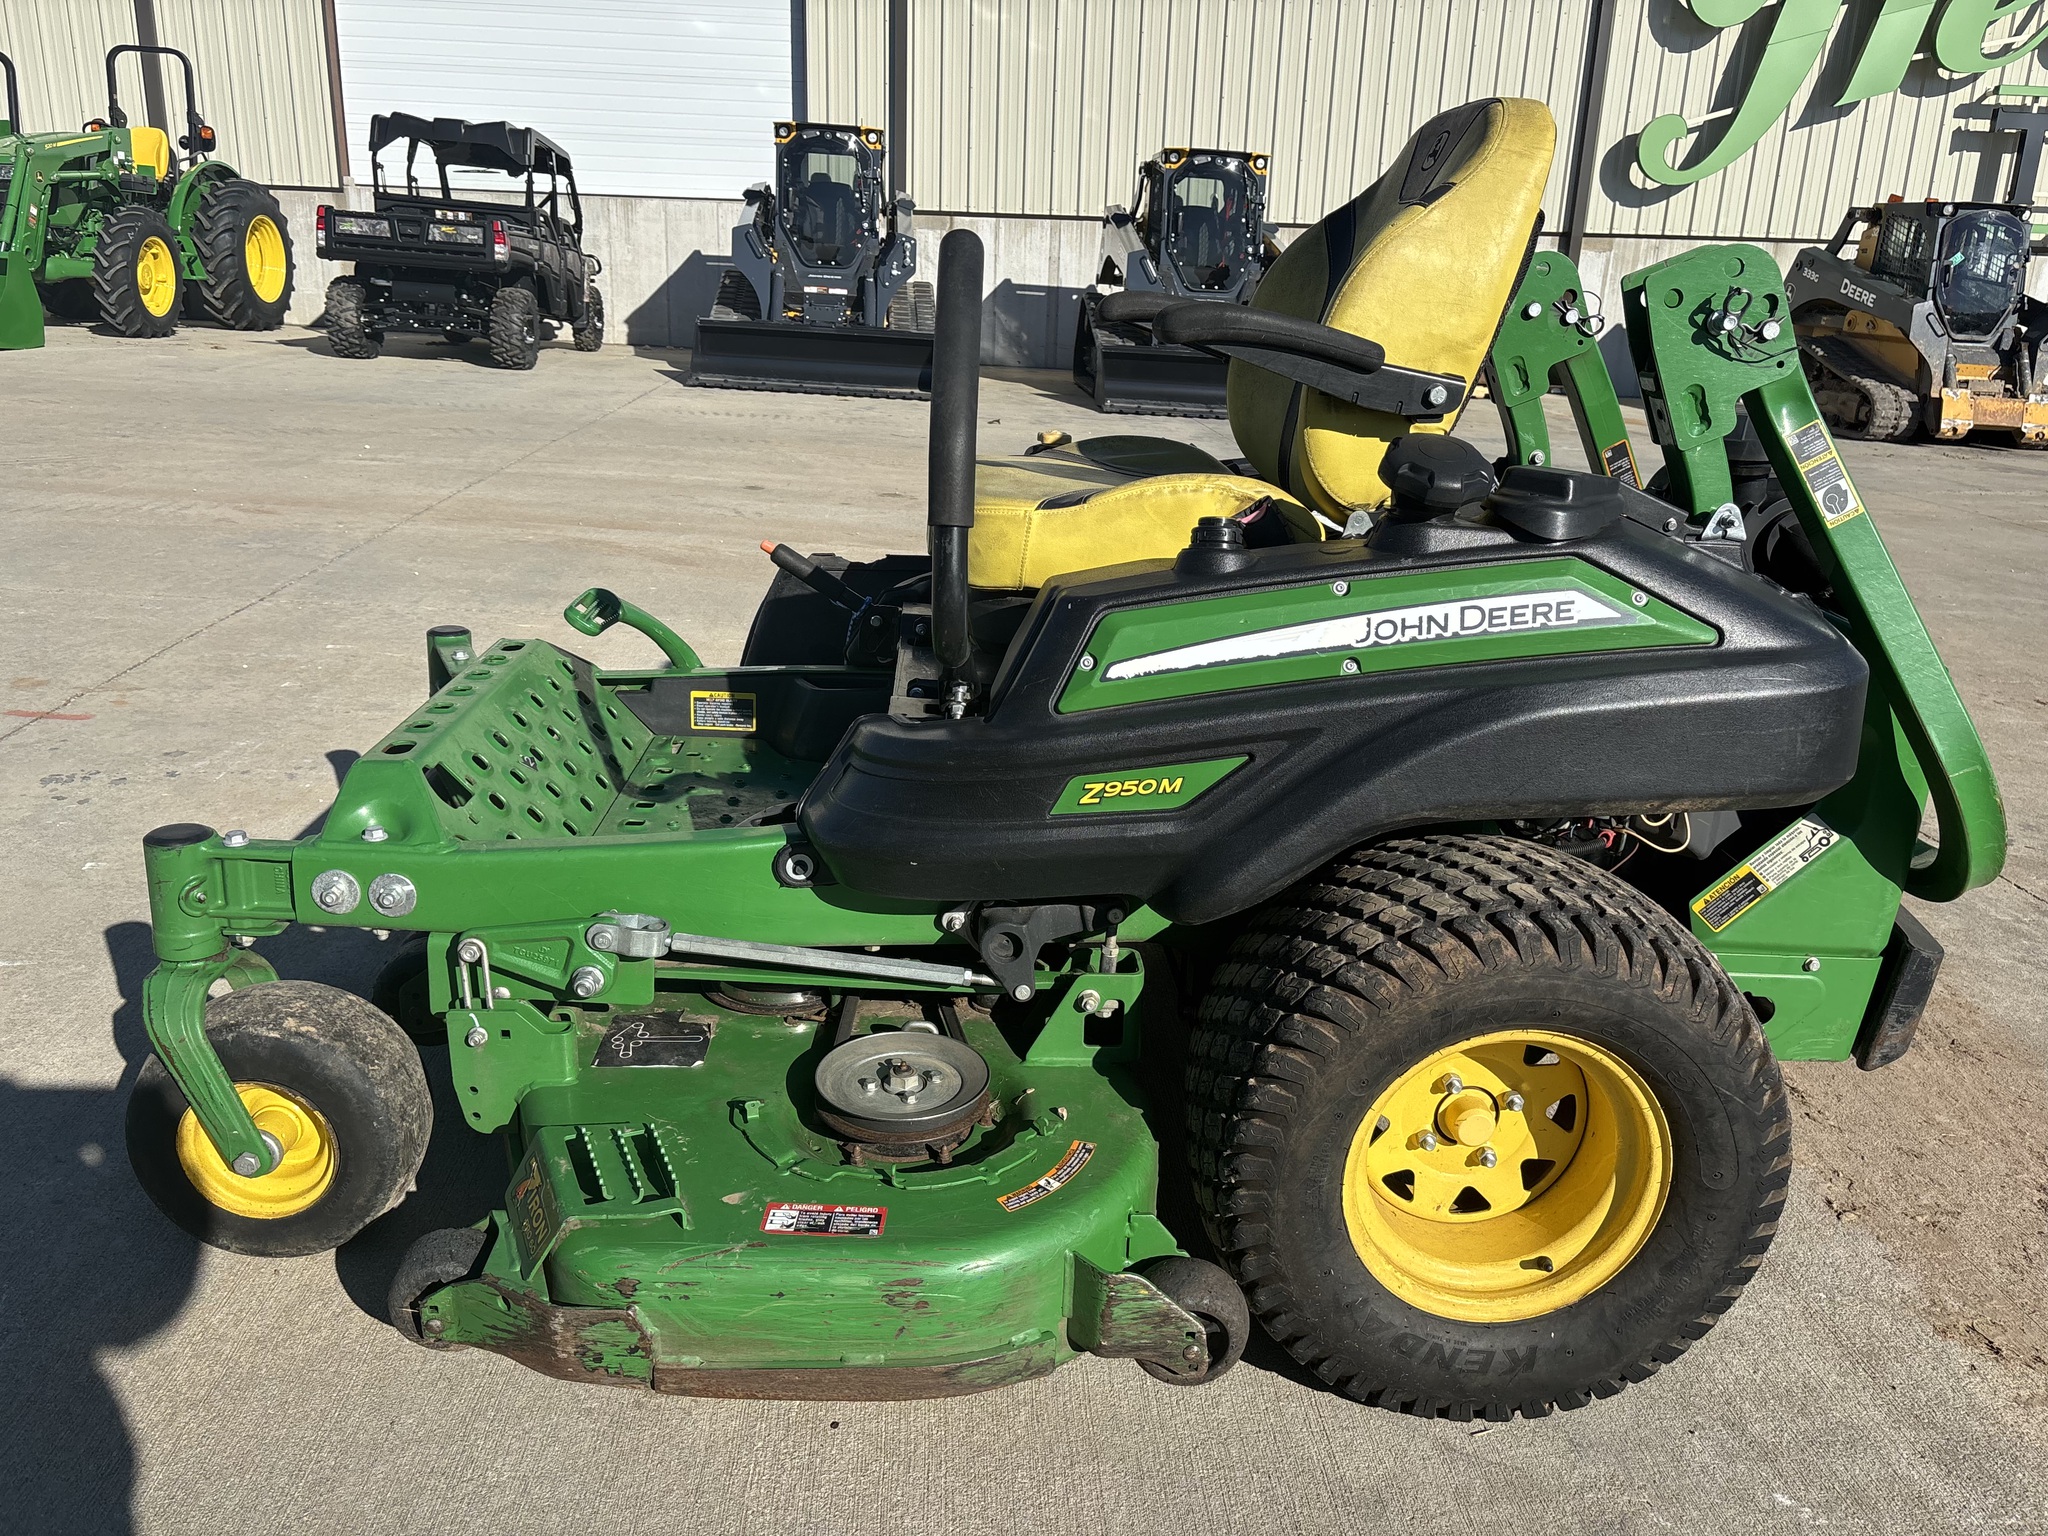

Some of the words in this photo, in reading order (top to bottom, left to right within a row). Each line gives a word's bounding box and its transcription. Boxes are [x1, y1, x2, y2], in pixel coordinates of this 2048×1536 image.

[1802, 267, 1820, 283] 333G
[1839, 277, 1877, 308] DEERE
[1829, 509, 1856, 527] CAUTION
[1354, 612, 1452, 646] JOHN
[1458, 599, 1577, 631] DEERE
[1077, 776, 1185, 806] Z950M
[1708, 873, 1740, 900] ATENCIÓN
[526, 1188, 548, 1244] IRON
[791, 1203, 824, 1212] DANGER
[1359, 1307, 1539, 1377] KENDA
